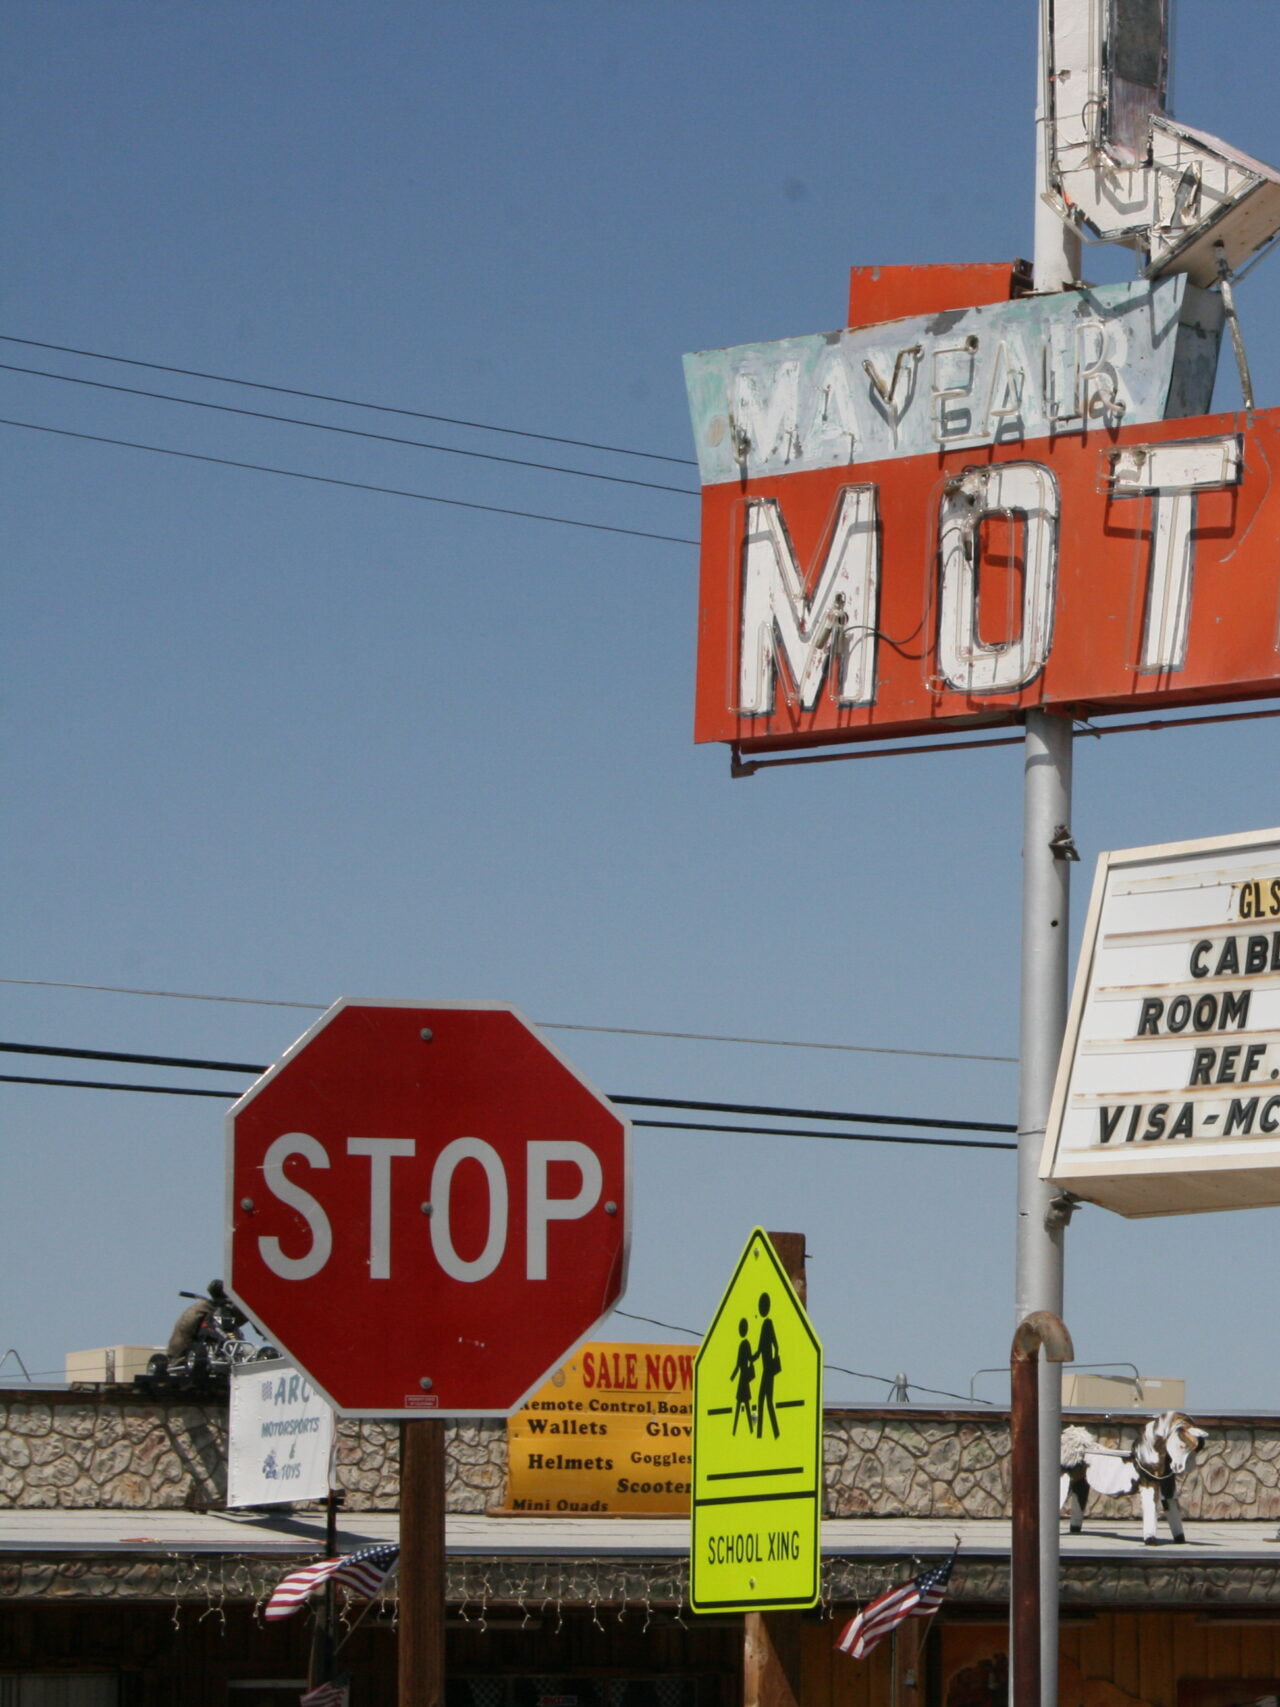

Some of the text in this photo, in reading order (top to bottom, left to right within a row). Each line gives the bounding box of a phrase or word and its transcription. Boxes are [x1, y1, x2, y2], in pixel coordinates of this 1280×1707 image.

[1136, 990, 1253, 1036] ROOM
[257, 1132, 603, 1283] STOP
[583, 1352, 694, 1391] SALE NOW
[261, 1417, 320, 1438] MOTORSPORTS
[527, 1419, 608, 1436] Wallets
[281, 1463, 302, 1481] TOYS
[528, 1454, 614, 1471] Helmets
[512, 1500, 550, 1512] Mini
[708, 1530, 800, 1565] SCHOOL XING
